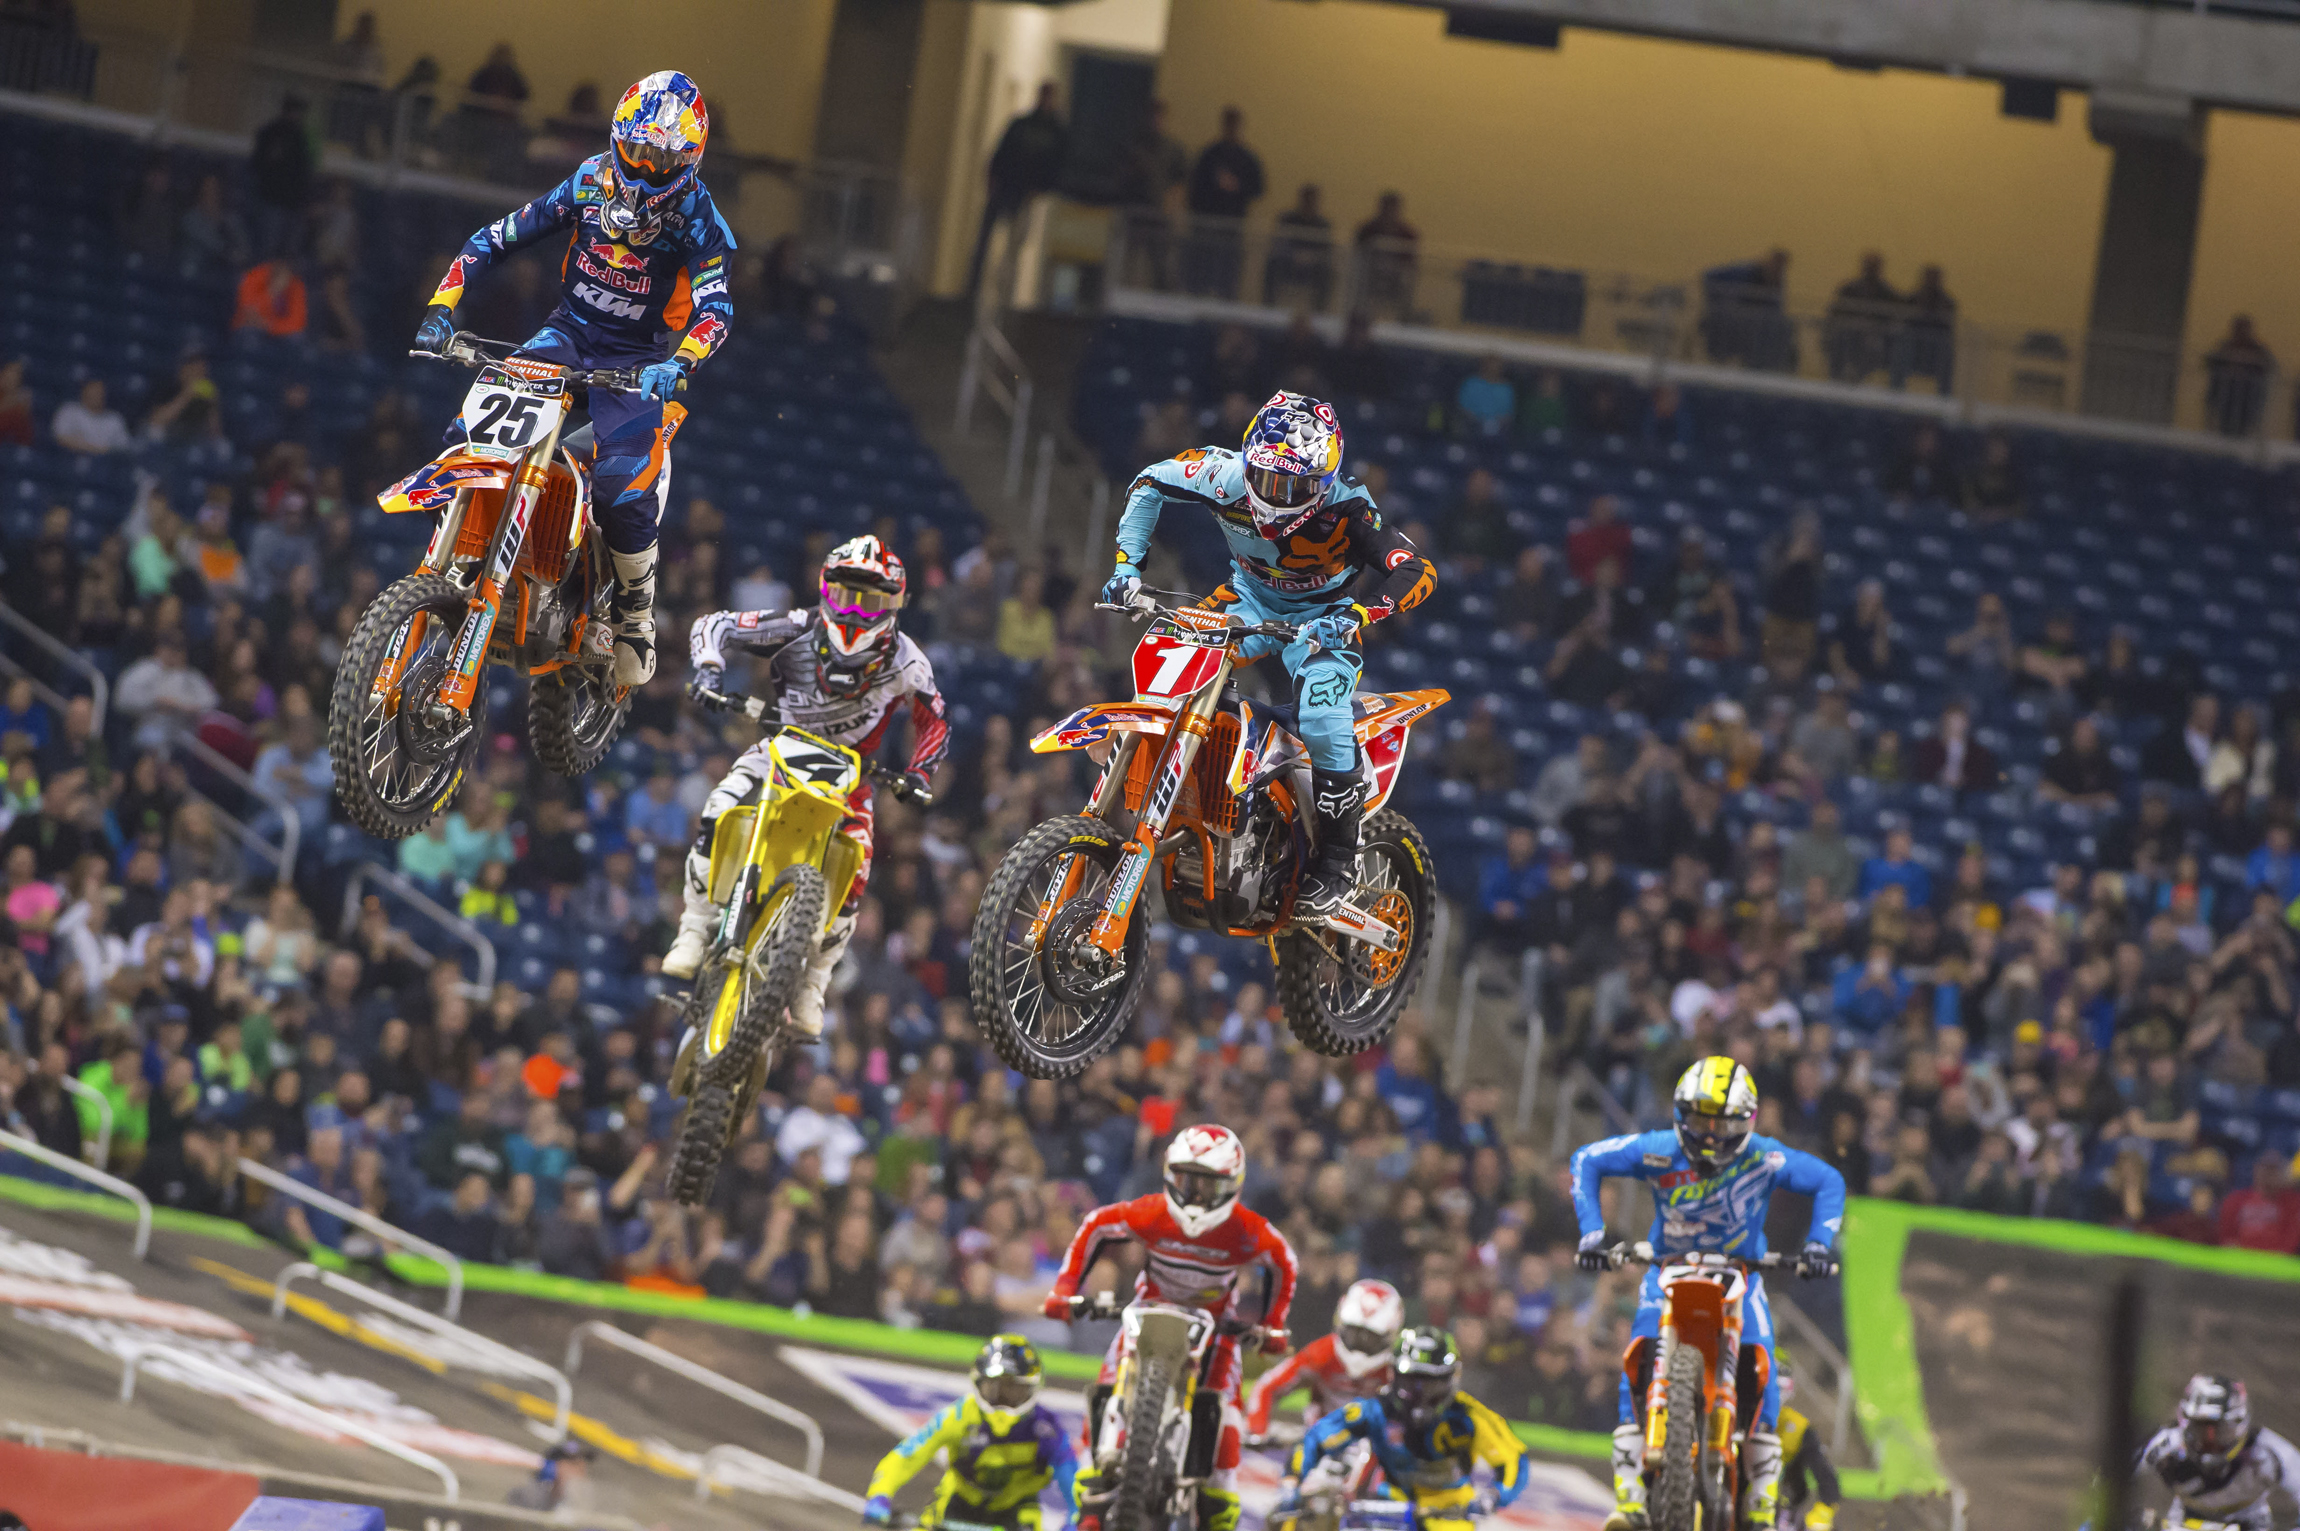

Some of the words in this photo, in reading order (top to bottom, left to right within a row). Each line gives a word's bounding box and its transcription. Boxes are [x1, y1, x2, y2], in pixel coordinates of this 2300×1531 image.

[576, 251, 611, 284] Red
[611, 270, 651, 295] Bull
[572, 281, 647, 321] KTM
[468, 393, 546, 448] 25
[630, 455, 650, 477] THOR
[1250, 452, 1275, 464] Red
[1276, 456, 1302, 474] Bull
[1279, 574, 1329, 591] Bull
[469, 613, 493, 661] MOTOREX
[1146, 645, 1200, 695] 1
[1396, 703, 1428, 725] DUNLOP
[1120, 855, 1148, 902] MOTOREX
[1339, 907, 1366, 925] ENTHAL
